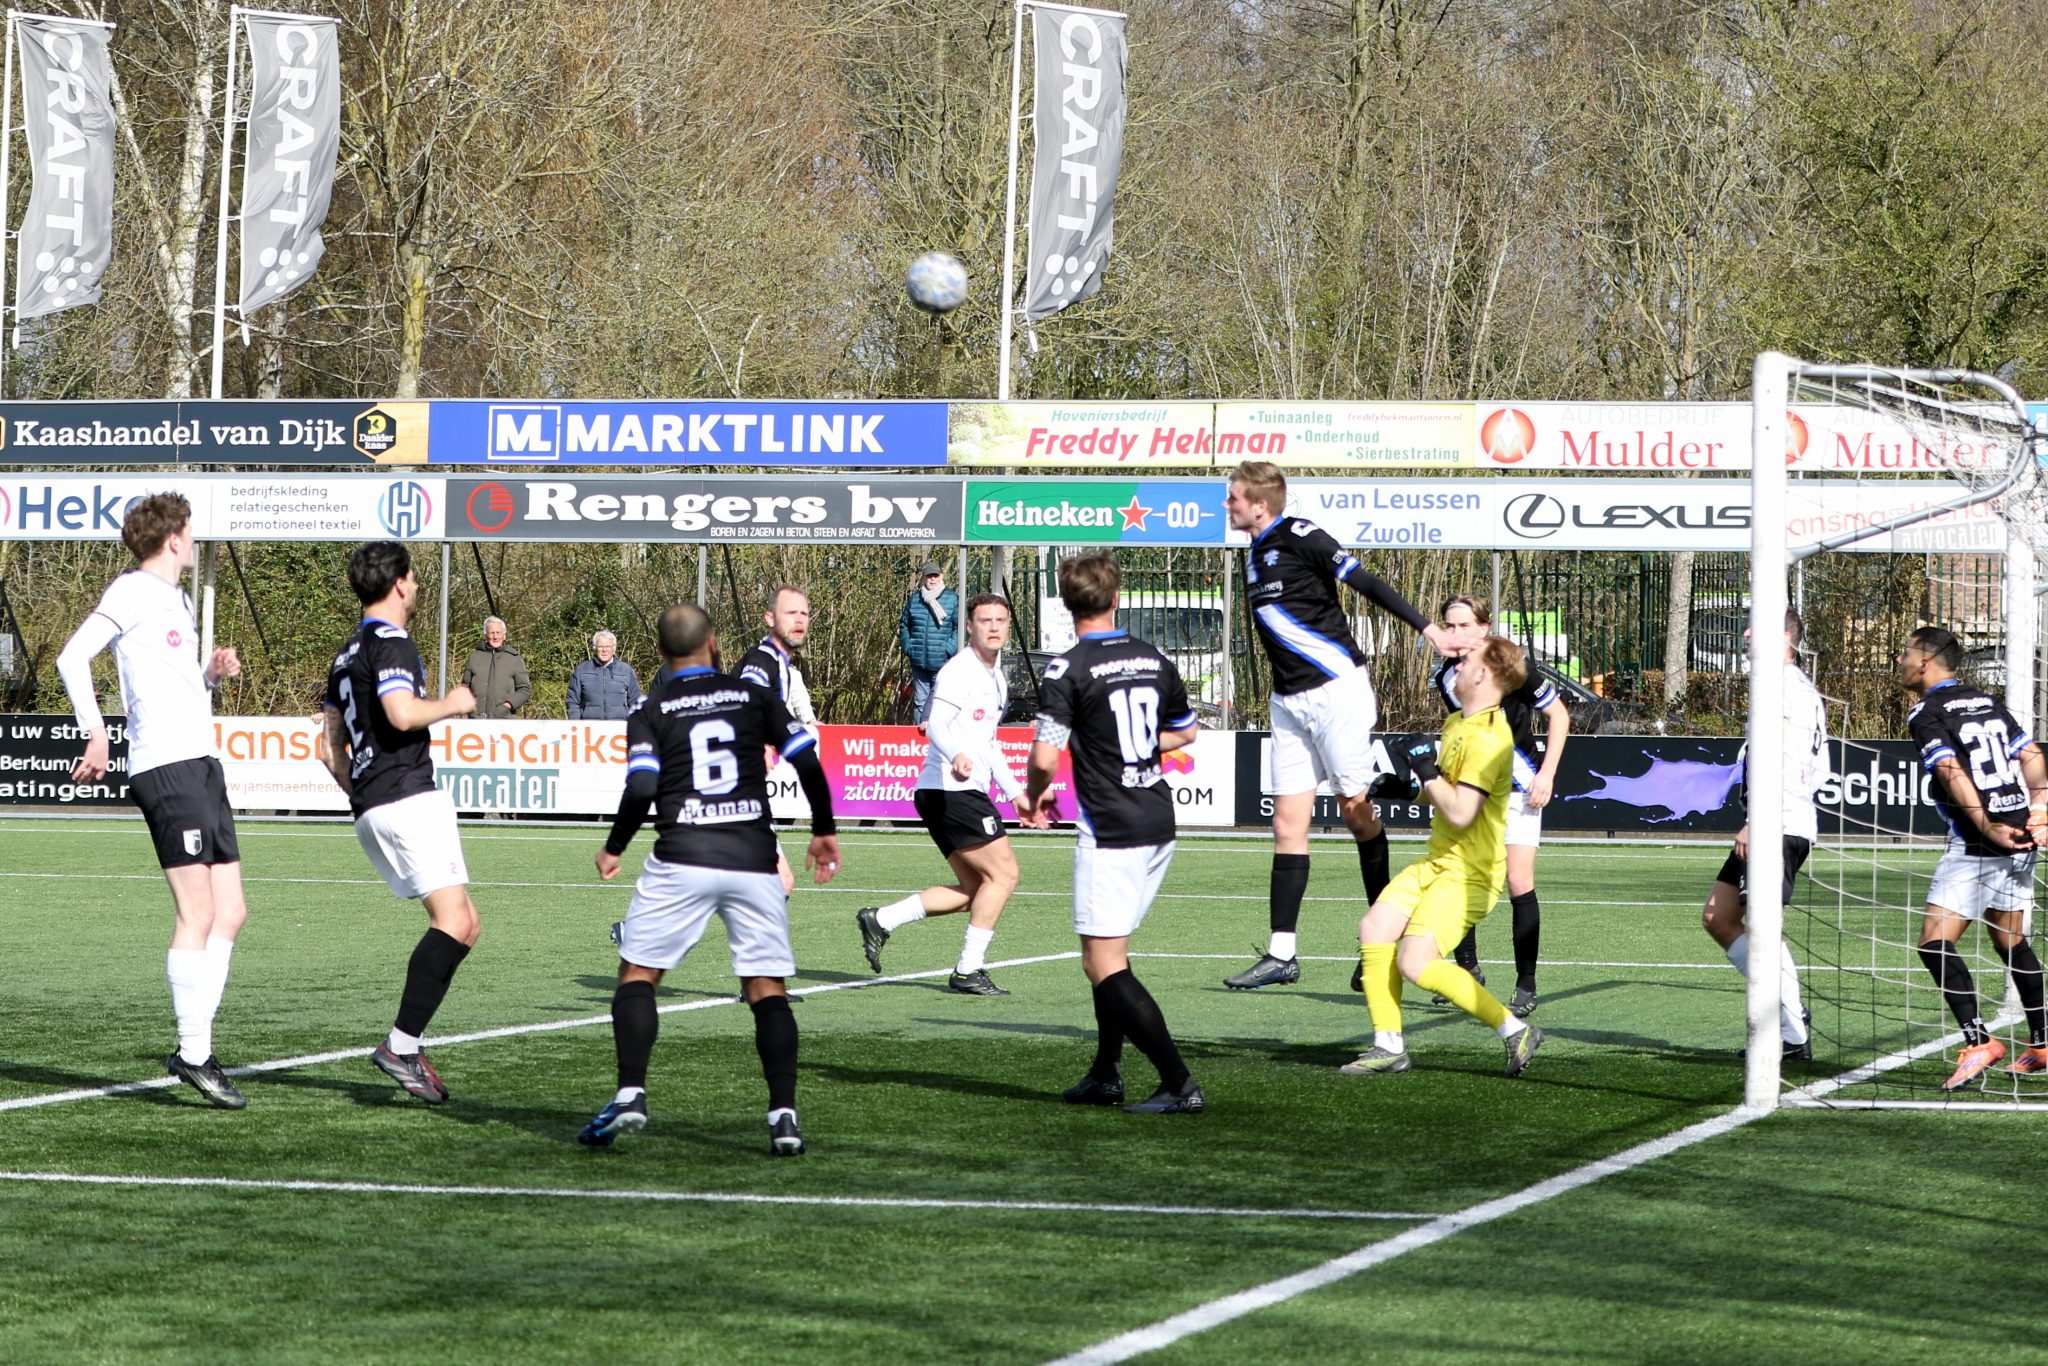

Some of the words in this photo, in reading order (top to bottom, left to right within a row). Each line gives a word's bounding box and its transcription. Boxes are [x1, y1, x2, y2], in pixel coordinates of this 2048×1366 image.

[43, 28, 86, 247] CRAFT
[270, 25, 318, 239] CRAFT
[1058, 14, 1102, 246] CRAFT
[1052, 409, 1168, 424] Hoveniersbedrijf
[1257, 411, 1332, 425] Tuinaanleg
[13, 420, 202, 446] Kaashandel
[210, 425, 270, 446] van
[279, 420, 346, 452] Dijk
[566, 414, 885, 453] MARKTLINK
[1025, 427, 1139, 462] Freddy
[1148, 427, 1287, 458] Hekman
[1304, 430, 1380, 443] Onderhoud
[364, 441, 387, 450] kaas
[1356, 447, 1460, 462] Sierbestrating
[1558, 431, 1724, 467] Mulder
[231, 486, 328, 499] bedrijfskleding
[1320, 493, 1369, 509] van
[1374, 489, 1481, 511] Leussen
[230, 502, 349, 515] relatiegeschenken
[523, 483, 828, 532] Rengers
[847, 484, 937, 524] bv
[977, 500, 1114, 527] Heineken
[1572, 505, 1752, 528] LEXUS
[230, 520, 317, 532] promotioneel
[320, 519, 361, 530] textiel
[710, 527, 737, 537] BOREN
[737, 527, 748, 537] EN
[750, 527, 776, 537] ZAGEN
[776, 527, 784, 537] IN
[786, 527, 812, 539] BETON,
[814, 528, 838, 538] STEEN
[839, 528, 849, 538] EN
[851, 528, 875, 538] ASFALT
[879, 528, 936, 539] SLOOPWERKEN.
[1356, 522, 1442, 543] Zwolle
[11, 725, 43, 739] uw
[1109, 686, 1160, 763] 10
[689, 719, 739, 795] 6
[843, 739, 874, 760] Wij
[1959, 719, 2016, 790] 20
[845, 760, 919, 778] merken
